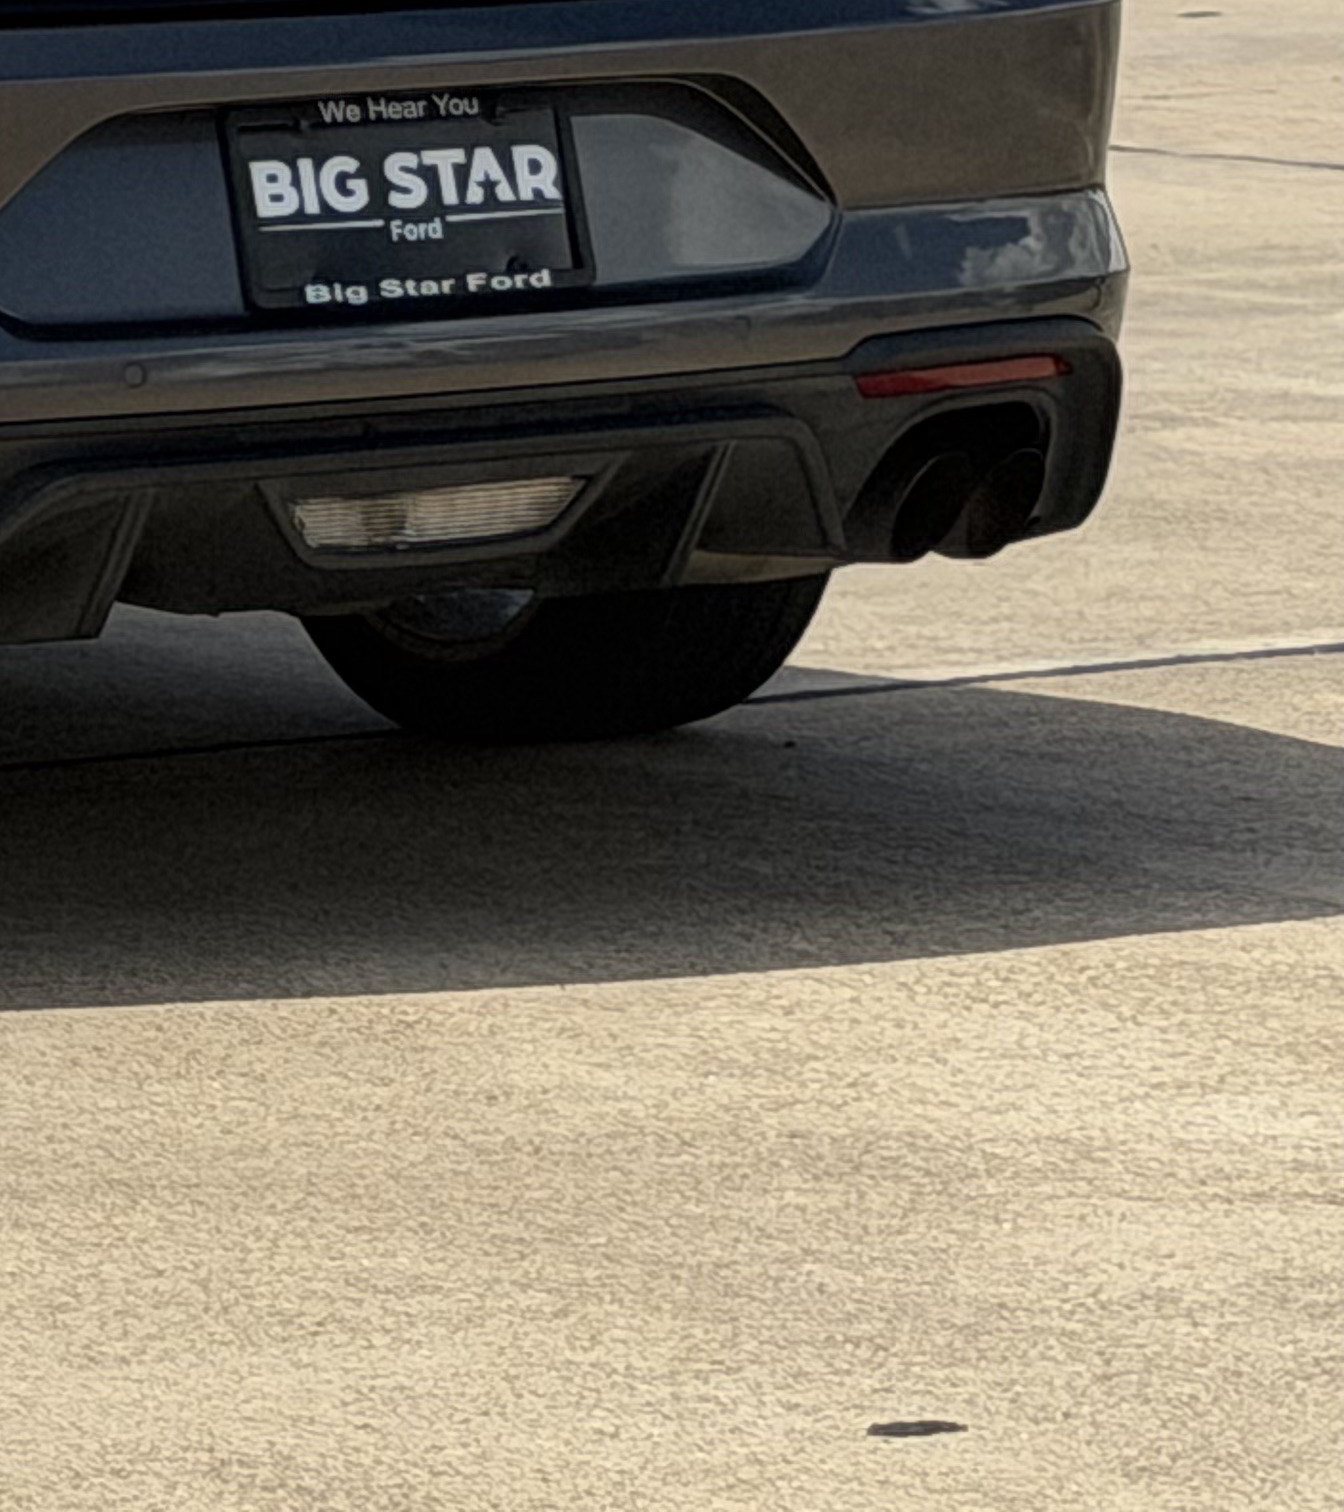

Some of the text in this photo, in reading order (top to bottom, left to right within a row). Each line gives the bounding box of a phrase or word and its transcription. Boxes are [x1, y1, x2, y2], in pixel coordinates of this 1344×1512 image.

[317, 92, 479, 124] We Hear You
[248, 144, 564, 218] BIG STAR
[390, 217, 444, 242] Ford
[304, 267, 552, 305] Big Star Ford
